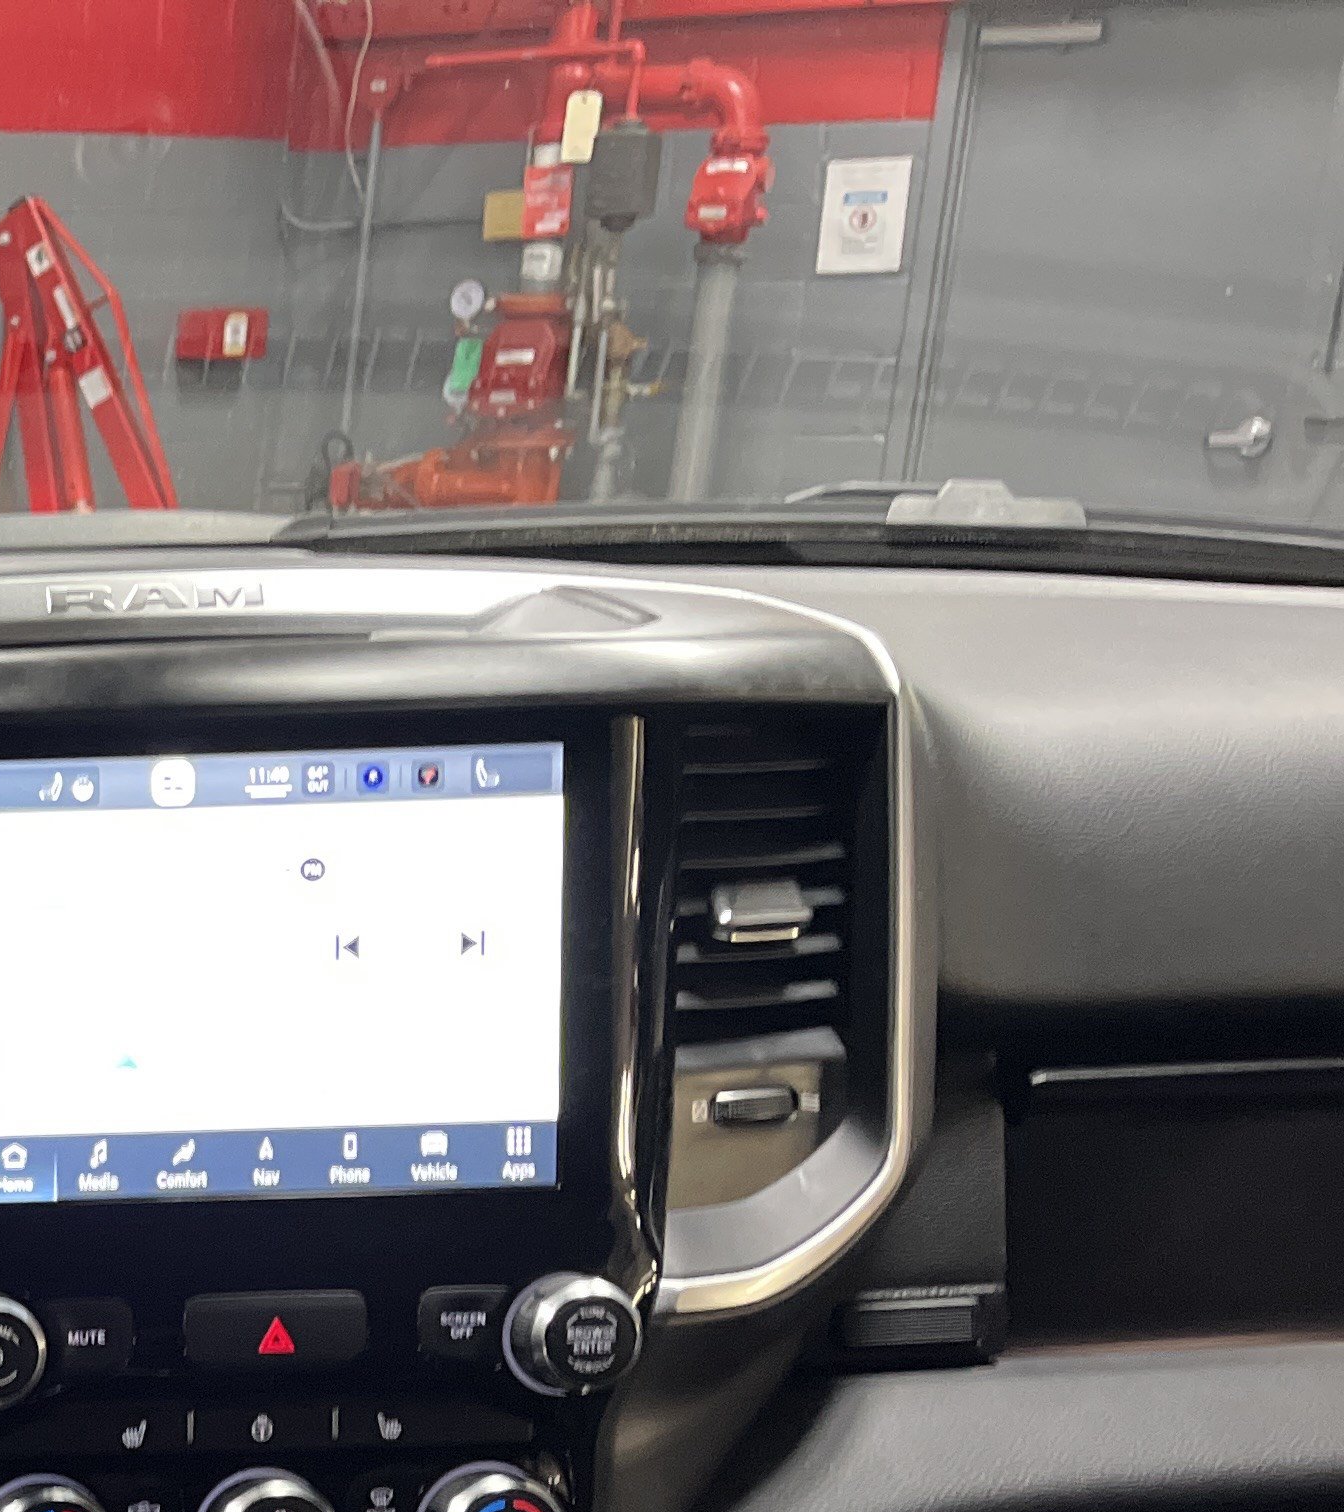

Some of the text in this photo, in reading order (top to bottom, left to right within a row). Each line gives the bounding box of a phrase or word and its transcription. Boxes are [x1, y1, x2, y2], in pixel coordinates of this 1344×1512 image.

[45, 583, 263, 613] RAM
[157, 1169, 208, 1190] Comfort
[253, 1169, 280, 1187] Nav
[329, 1163, 370, 1185] Phone
[410, 1162, 458, 1183] Vehicle
[502, 1161, 536, 1182] Apps
[78, 1173, 118, 1192] Media
[440, 1310, 487, 1327] SCREEN
[67, 1329, 106, 1347] MUTE
